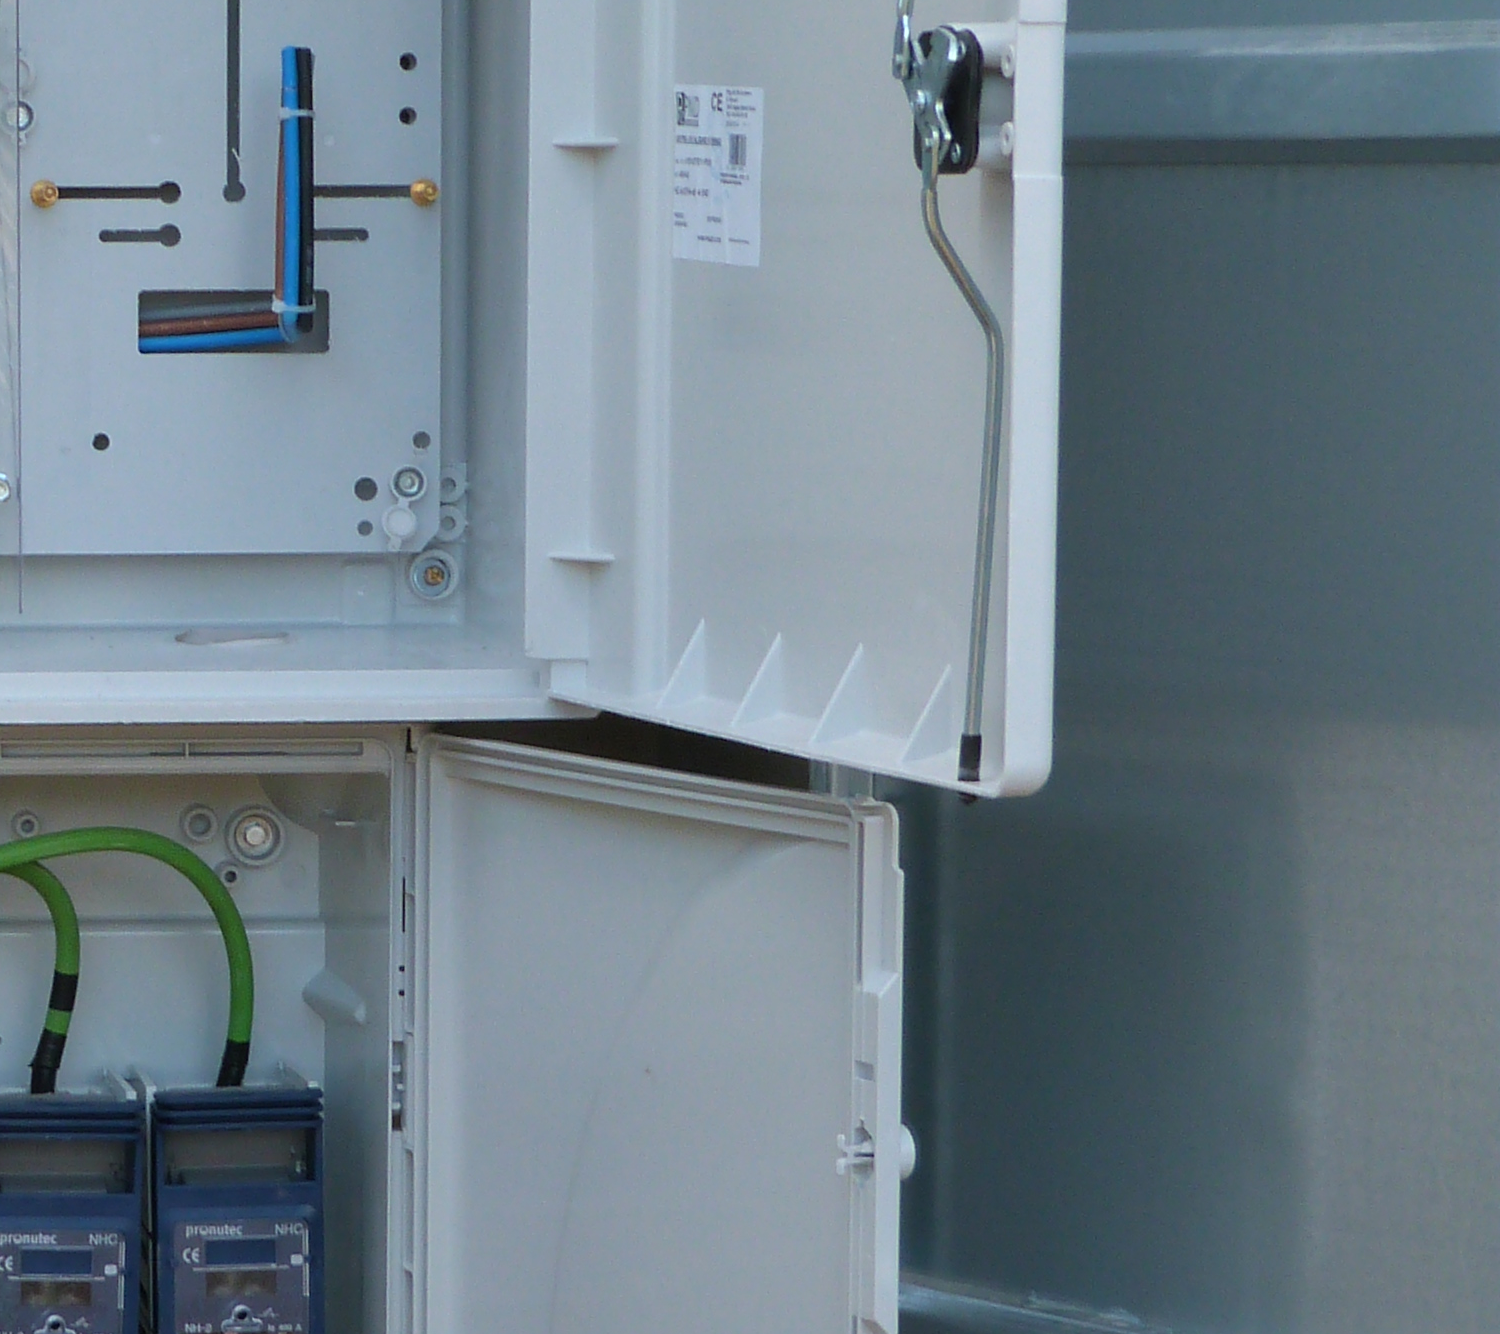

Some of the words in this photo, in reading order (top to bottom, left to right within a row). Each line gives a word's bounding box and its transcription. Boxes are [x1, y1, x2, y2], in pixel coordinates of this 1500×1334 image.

[0, 1232, 57, 1246] pronutec
[185, 1223, 243, 1239] pronutec
[182, 1247, 200, 1264] CE
